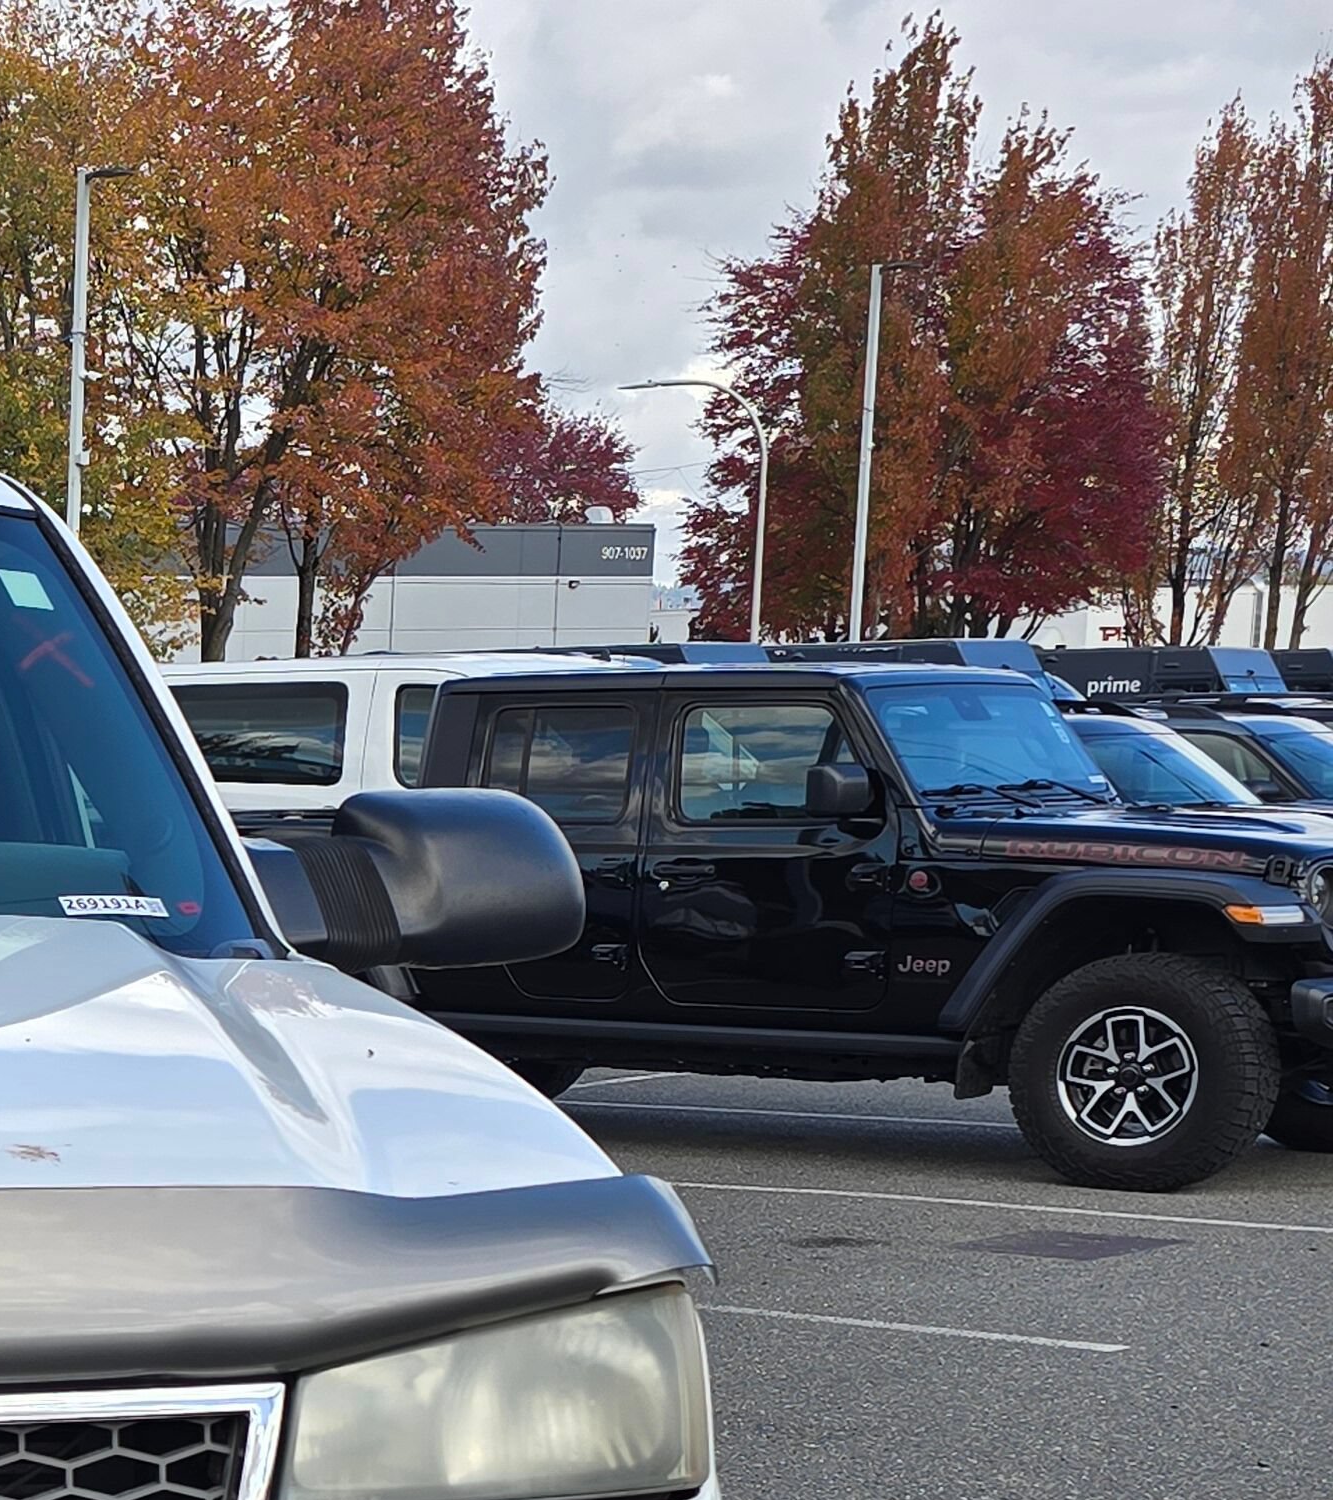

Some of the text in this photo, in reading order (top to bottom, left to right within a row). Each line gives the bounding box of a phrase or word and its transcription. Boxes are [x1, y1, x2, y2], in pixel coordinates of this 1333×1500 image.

[601, 546, 649, 560] 907-1037
[1087, 675, 1142, 697] prime
[1005, 840, 1246, 868] RUBICON
[63, 897, 147, 911] 269191A
[897, 955, 951, 977] Jeep
